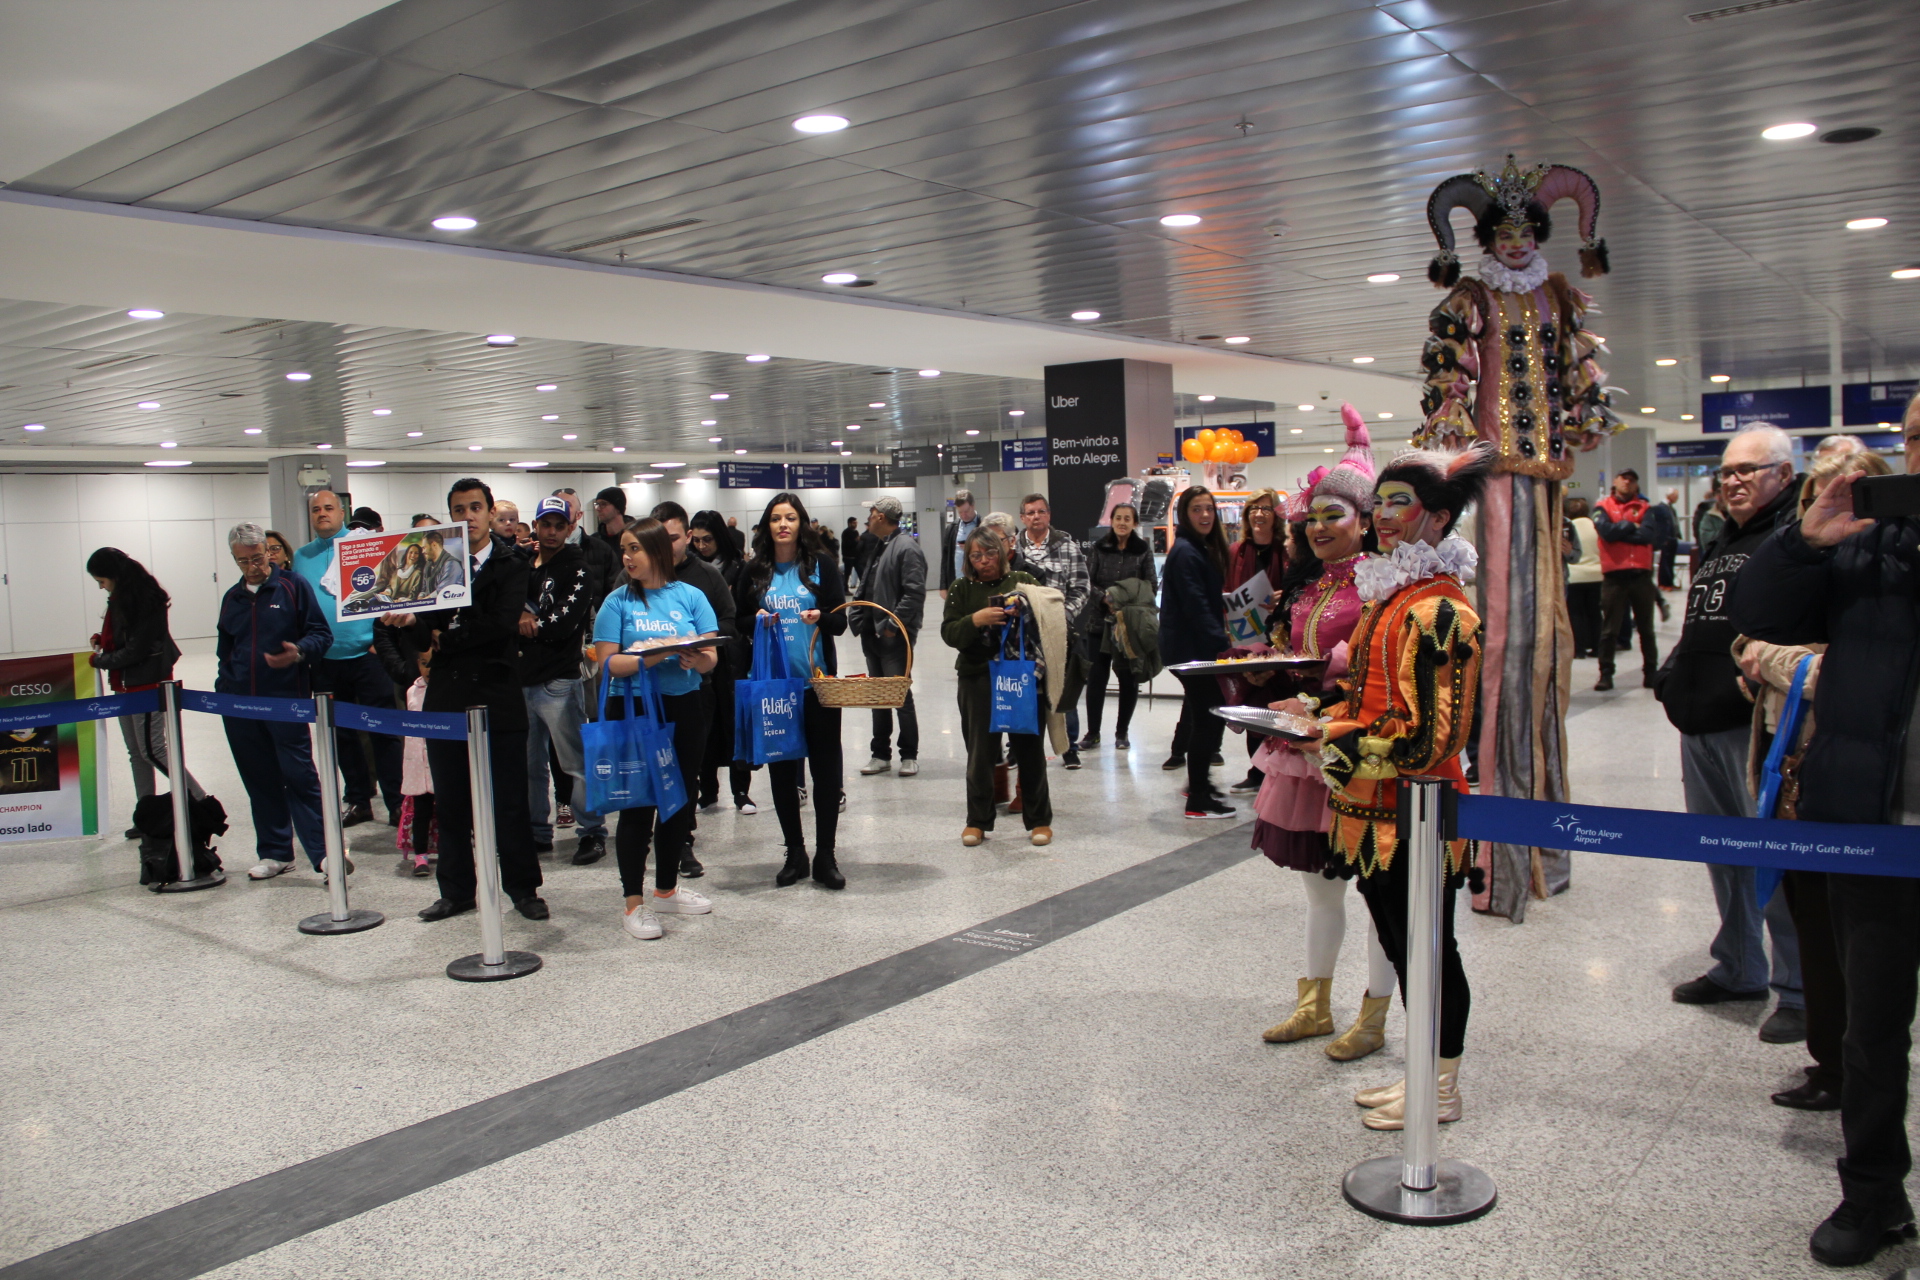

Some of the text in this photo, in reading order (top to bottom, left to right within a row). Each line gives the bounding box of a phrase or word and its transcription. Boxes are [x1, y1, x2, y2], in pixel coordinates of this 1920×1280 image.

[1051, 396, 1079, 408] Uber
[1052, 436, 1119, 449] Bem-vindo a
[1053, 452, 1120, 466] Porto Alegre.
[443, 590, 465, 599] Citral
[765, 594, 802, 615] Pelotas
[636, 619, 677, 637] Pelotas
[761, 697, 793, 720] Pelotas
[11, 757, 38, 783] 11
[0, 804, 42, 813] CHAMPION
[27, 822, 52, 833] lado
[1576, 827, 1623, 840] Porto Alegre
[1573, 835, 1602, 845] Airport
[1700, 836, 1875, 856] Boa Viagem! Nice Trip! Gute Reise!
